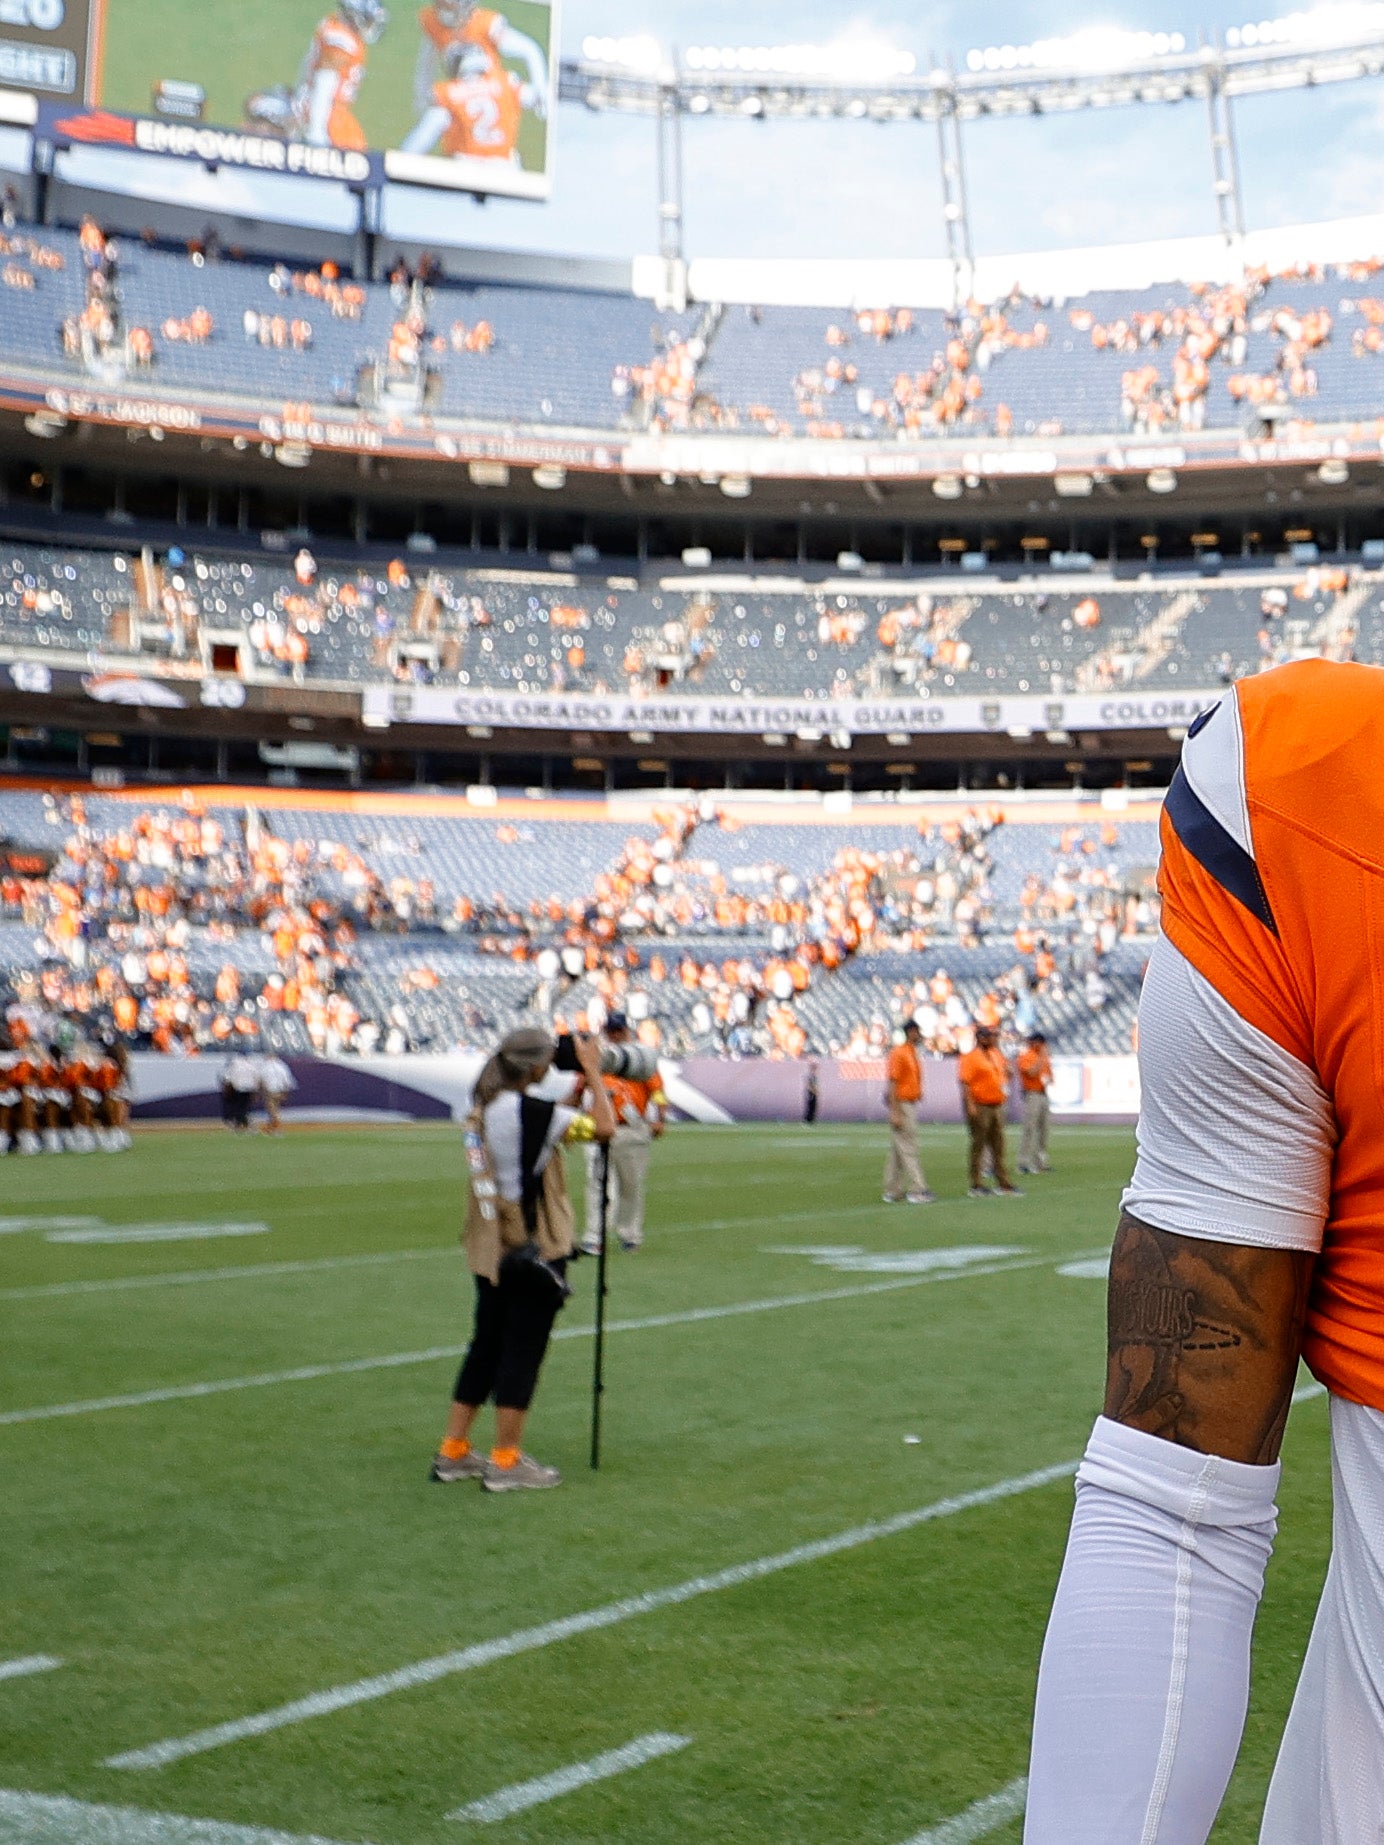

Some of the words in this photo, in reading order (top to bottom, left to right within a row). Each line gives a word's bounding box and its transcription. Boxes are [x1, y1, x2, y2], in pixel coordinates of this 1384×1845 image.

[465, 95, 505, 146] 2
[136, 119, 285, 170] EMPOWER
[287, 143, 370, 181] FIELD
[455, 699, 612, 721] COLORADO
[622, 703, 697, 723] ARMY
[709, 704, 843, 725] NATIONAL
[855, 705, 945, 725] GUARD
[1101, 700, 1214, 719] COLORA
